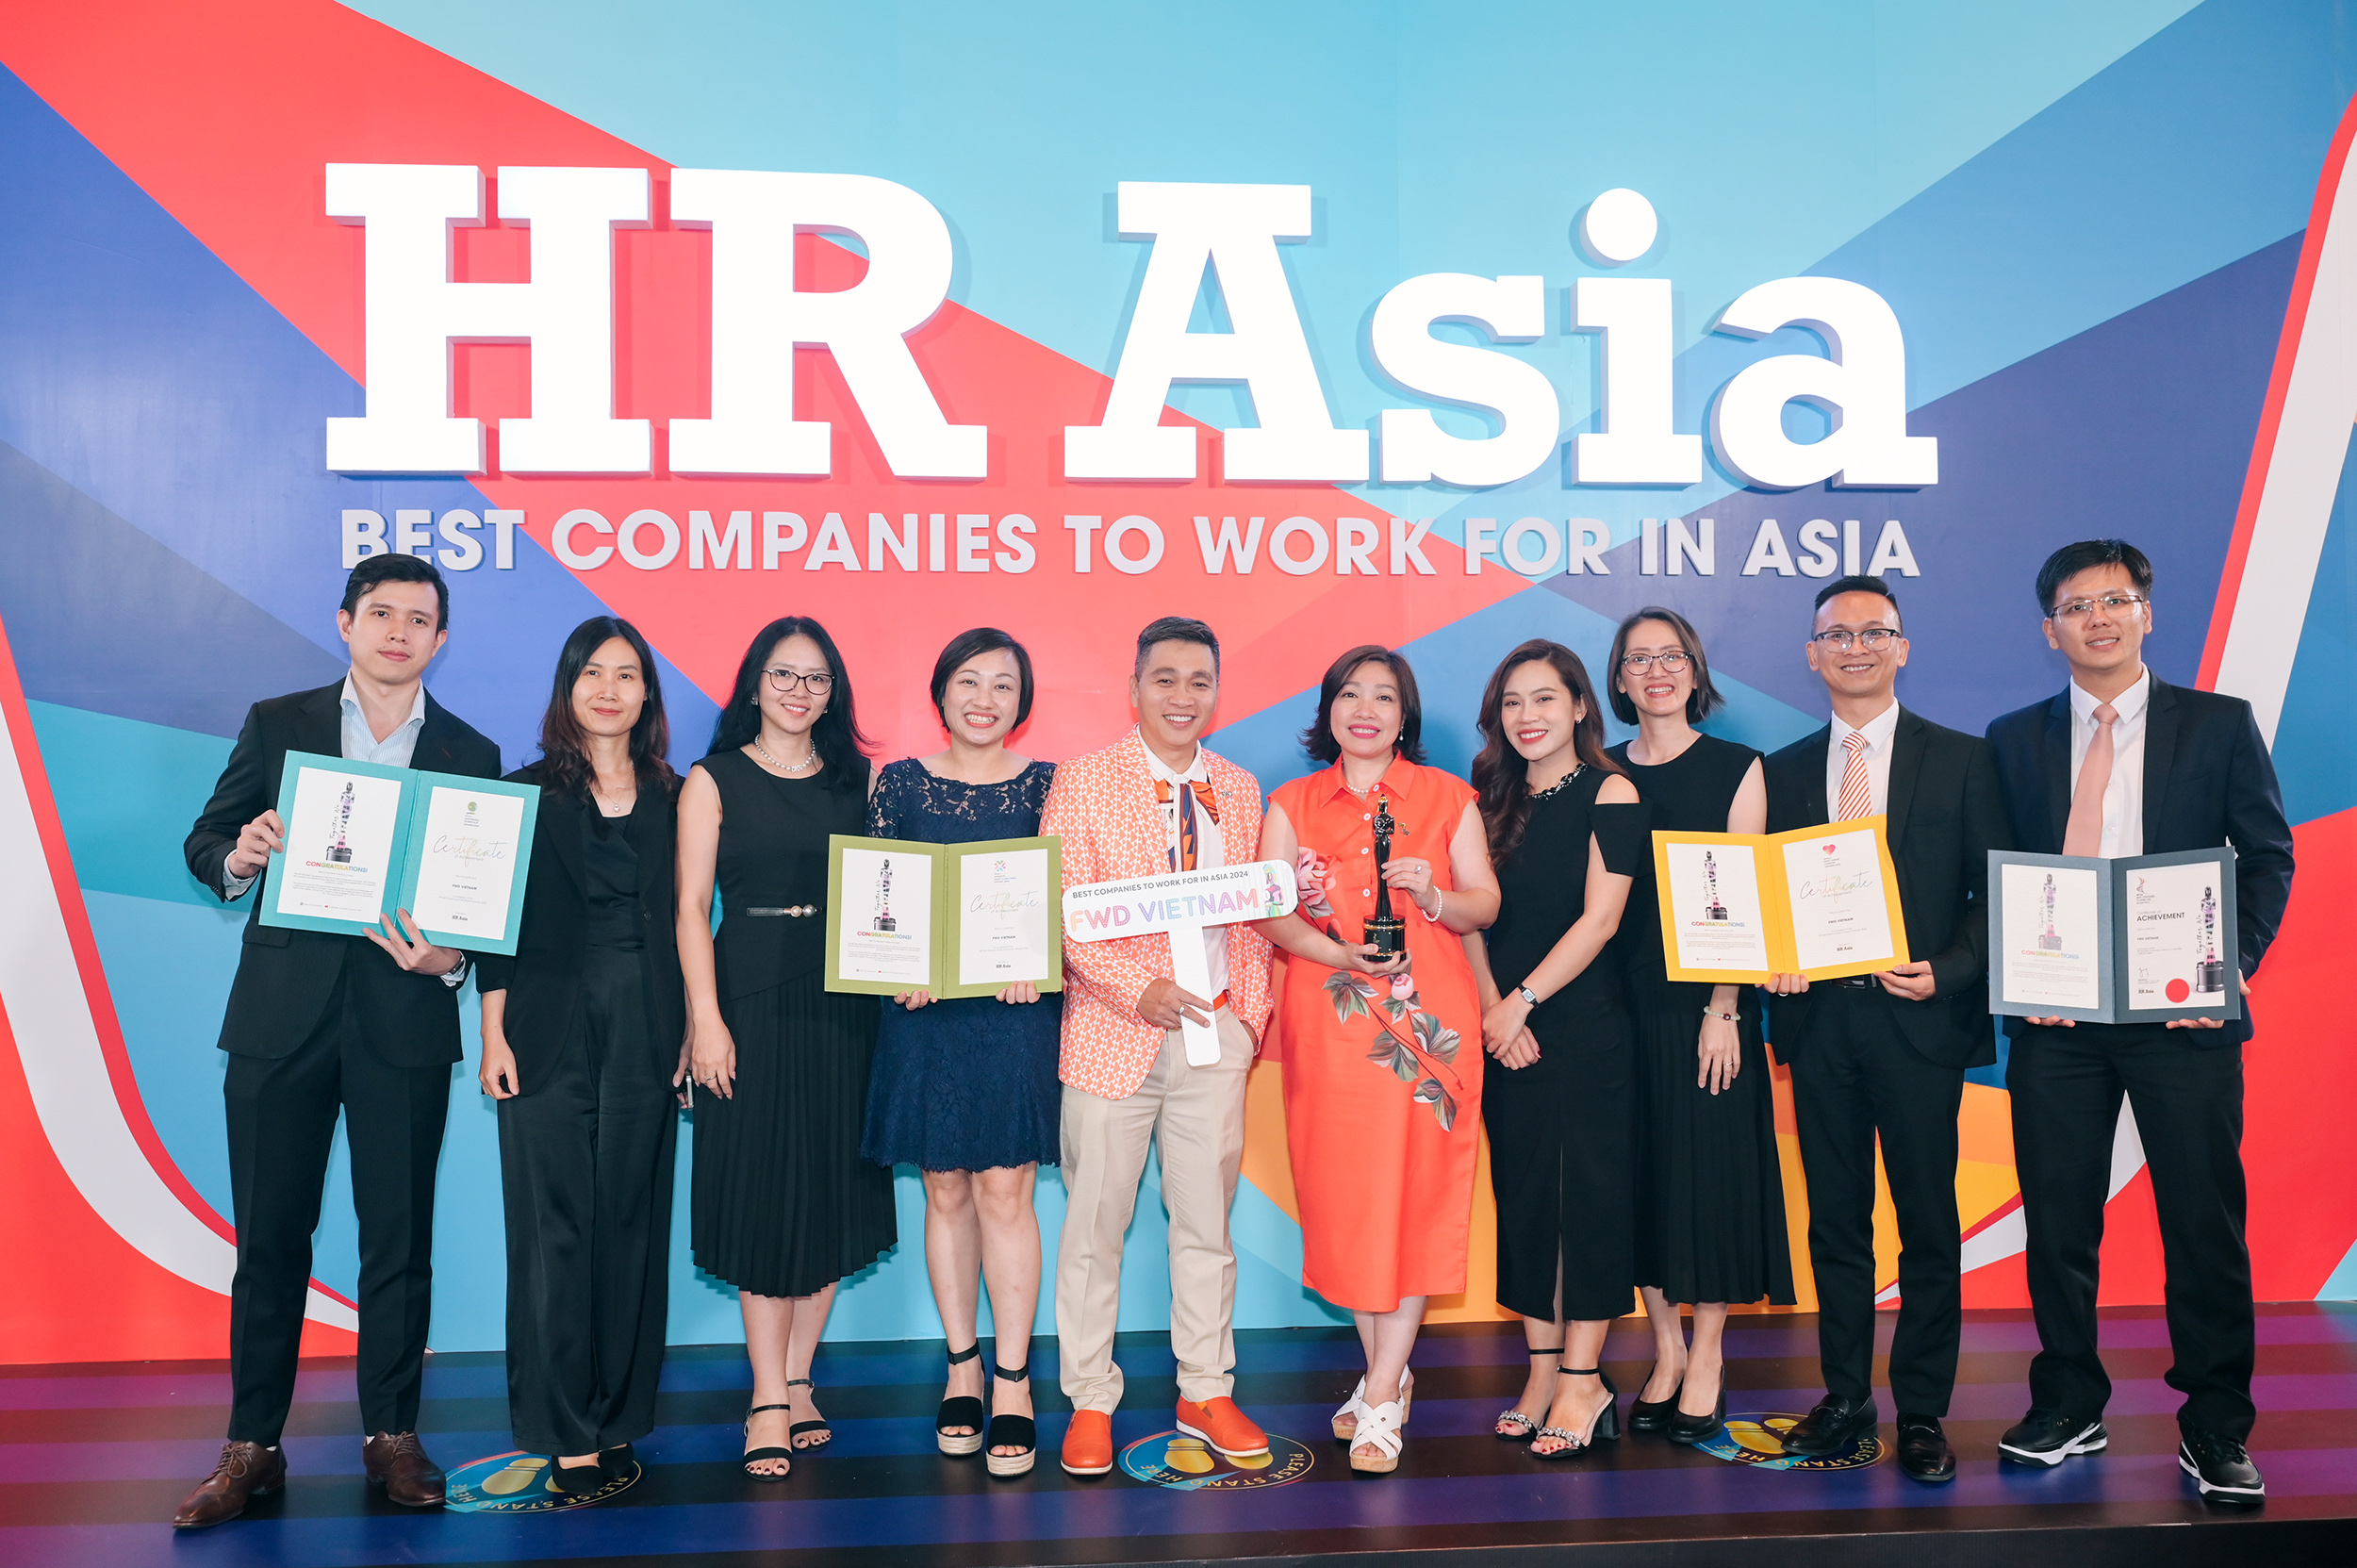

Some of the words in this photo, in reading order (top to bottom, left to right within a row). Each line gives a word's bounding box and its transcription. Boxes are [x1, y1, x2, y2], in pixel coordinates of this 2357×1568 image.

[325, 162, 988, 480] HR
[1063, 181, 1939, 489] Asia
[341, 508, 526, 571] BEST
[551, 508, 1038, 574] COMPANIES
[1063, 514, 1165, 575] TO
[1193, 516, 1438, 576] WORK
[1462, 517, 1612, 577] FOR
[1639, 518, 1716, 576] IN
[1740, 519, 1921, 578] ASIA
[305, 860, 369, 873] CONGRATULATIONS!
[1072, 890, 1093, 899] BEST
[1094, 883, 1142, 897] COMPANIES
[1155, 880, 1181, 888] WORK
[1229, 870, 1249, 879] 2024
[1070, 905, 1131, 933] FWD
[1137, 888, 1259, 923] VIETNAM
[2136, 912, 2185, 922] ACHIEVEMENT
[857, 931, 912, 940] CONGRATULATIONS!
[2021, 949, 2080, 960] CONGRATULATIONS!
[1849, 1439, 1875, 1461] LEASE
[1269, 1453, 1305, 1480] PLEASE
[1190, 1477, 1267, 1487] STAND
